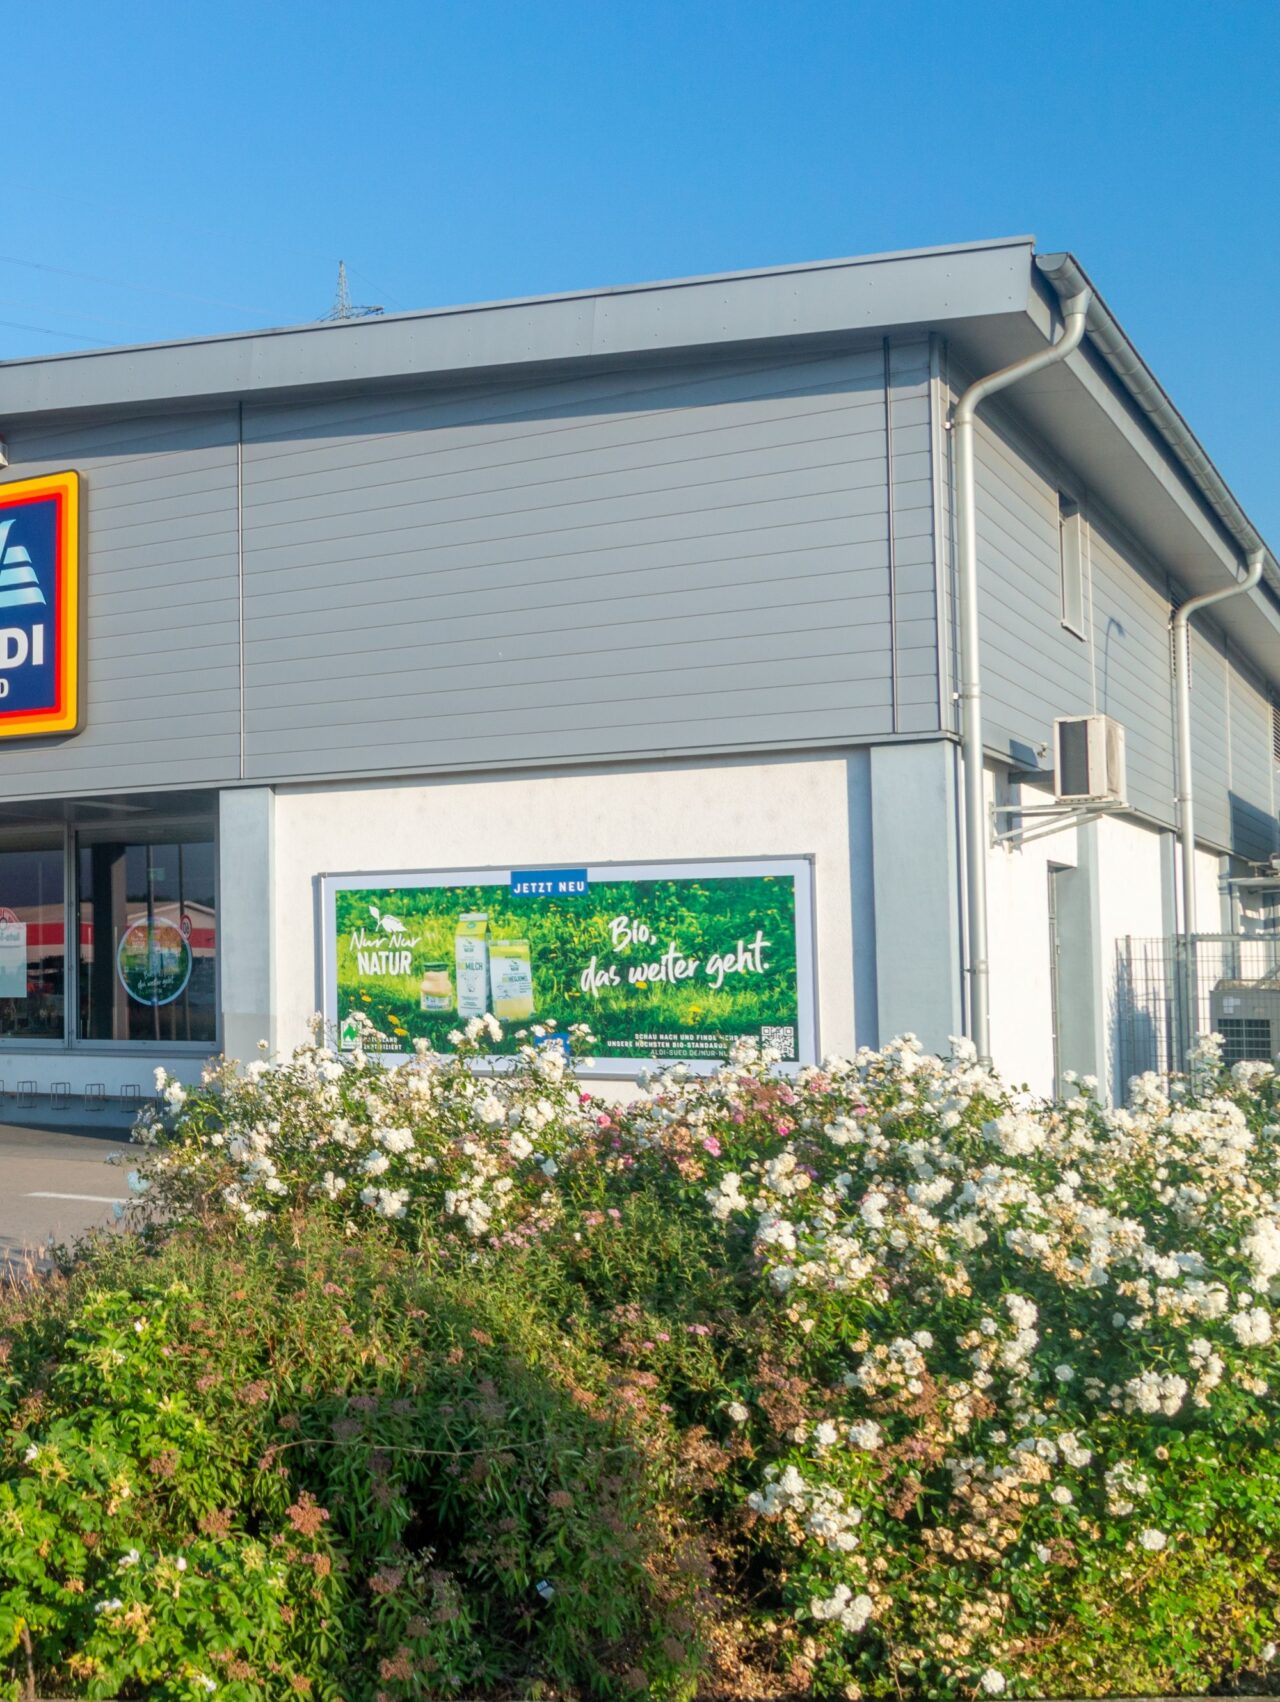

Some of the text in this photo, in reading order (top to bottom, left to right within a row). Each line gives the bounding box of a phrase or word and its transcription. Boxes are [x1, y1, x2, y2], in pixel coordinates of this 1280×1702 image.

[513, 881, 585, 894] JETZT NEU
[349, 927, 423, 952] Nur Nur
[608, 915, 657, 952] Bio,
[357, 950, 412, 976] NATUR
[580, 930, 771, 998] das weiter geht.
